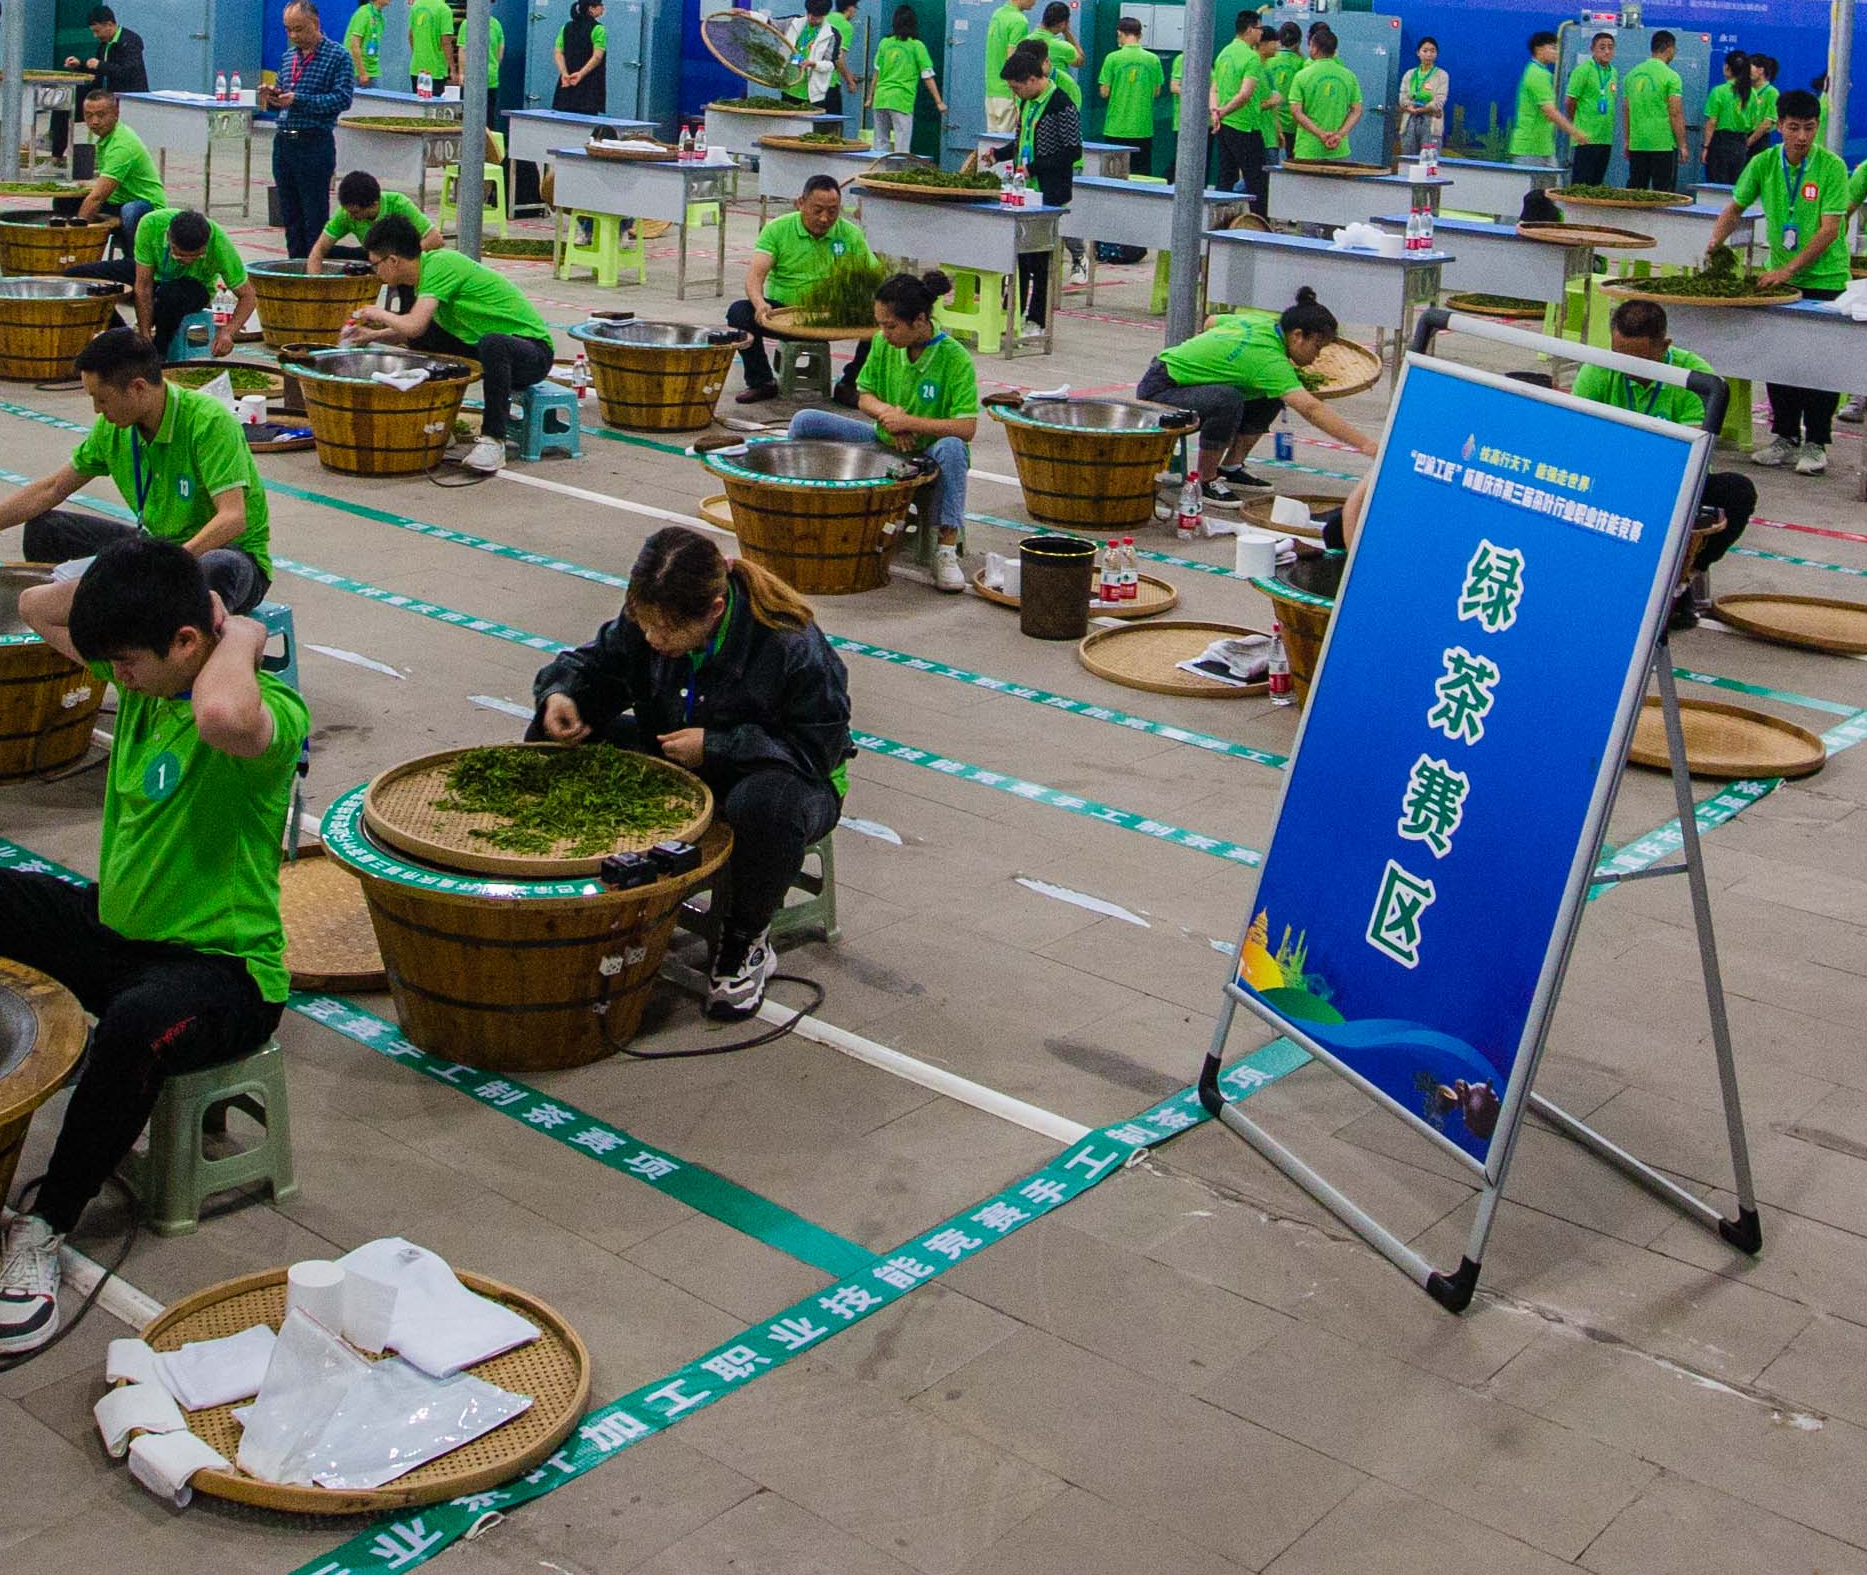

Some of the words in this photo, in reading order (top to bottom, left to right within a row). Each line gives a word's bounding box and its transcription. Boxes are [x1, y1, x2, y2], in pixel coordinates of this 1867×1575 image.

[922, 385, 935, 399] 24
[179, 480, 190, 496] 13
[1365, 537, 1527, 970] 绿茶赛区
[157, 763, 166, 790] 1
